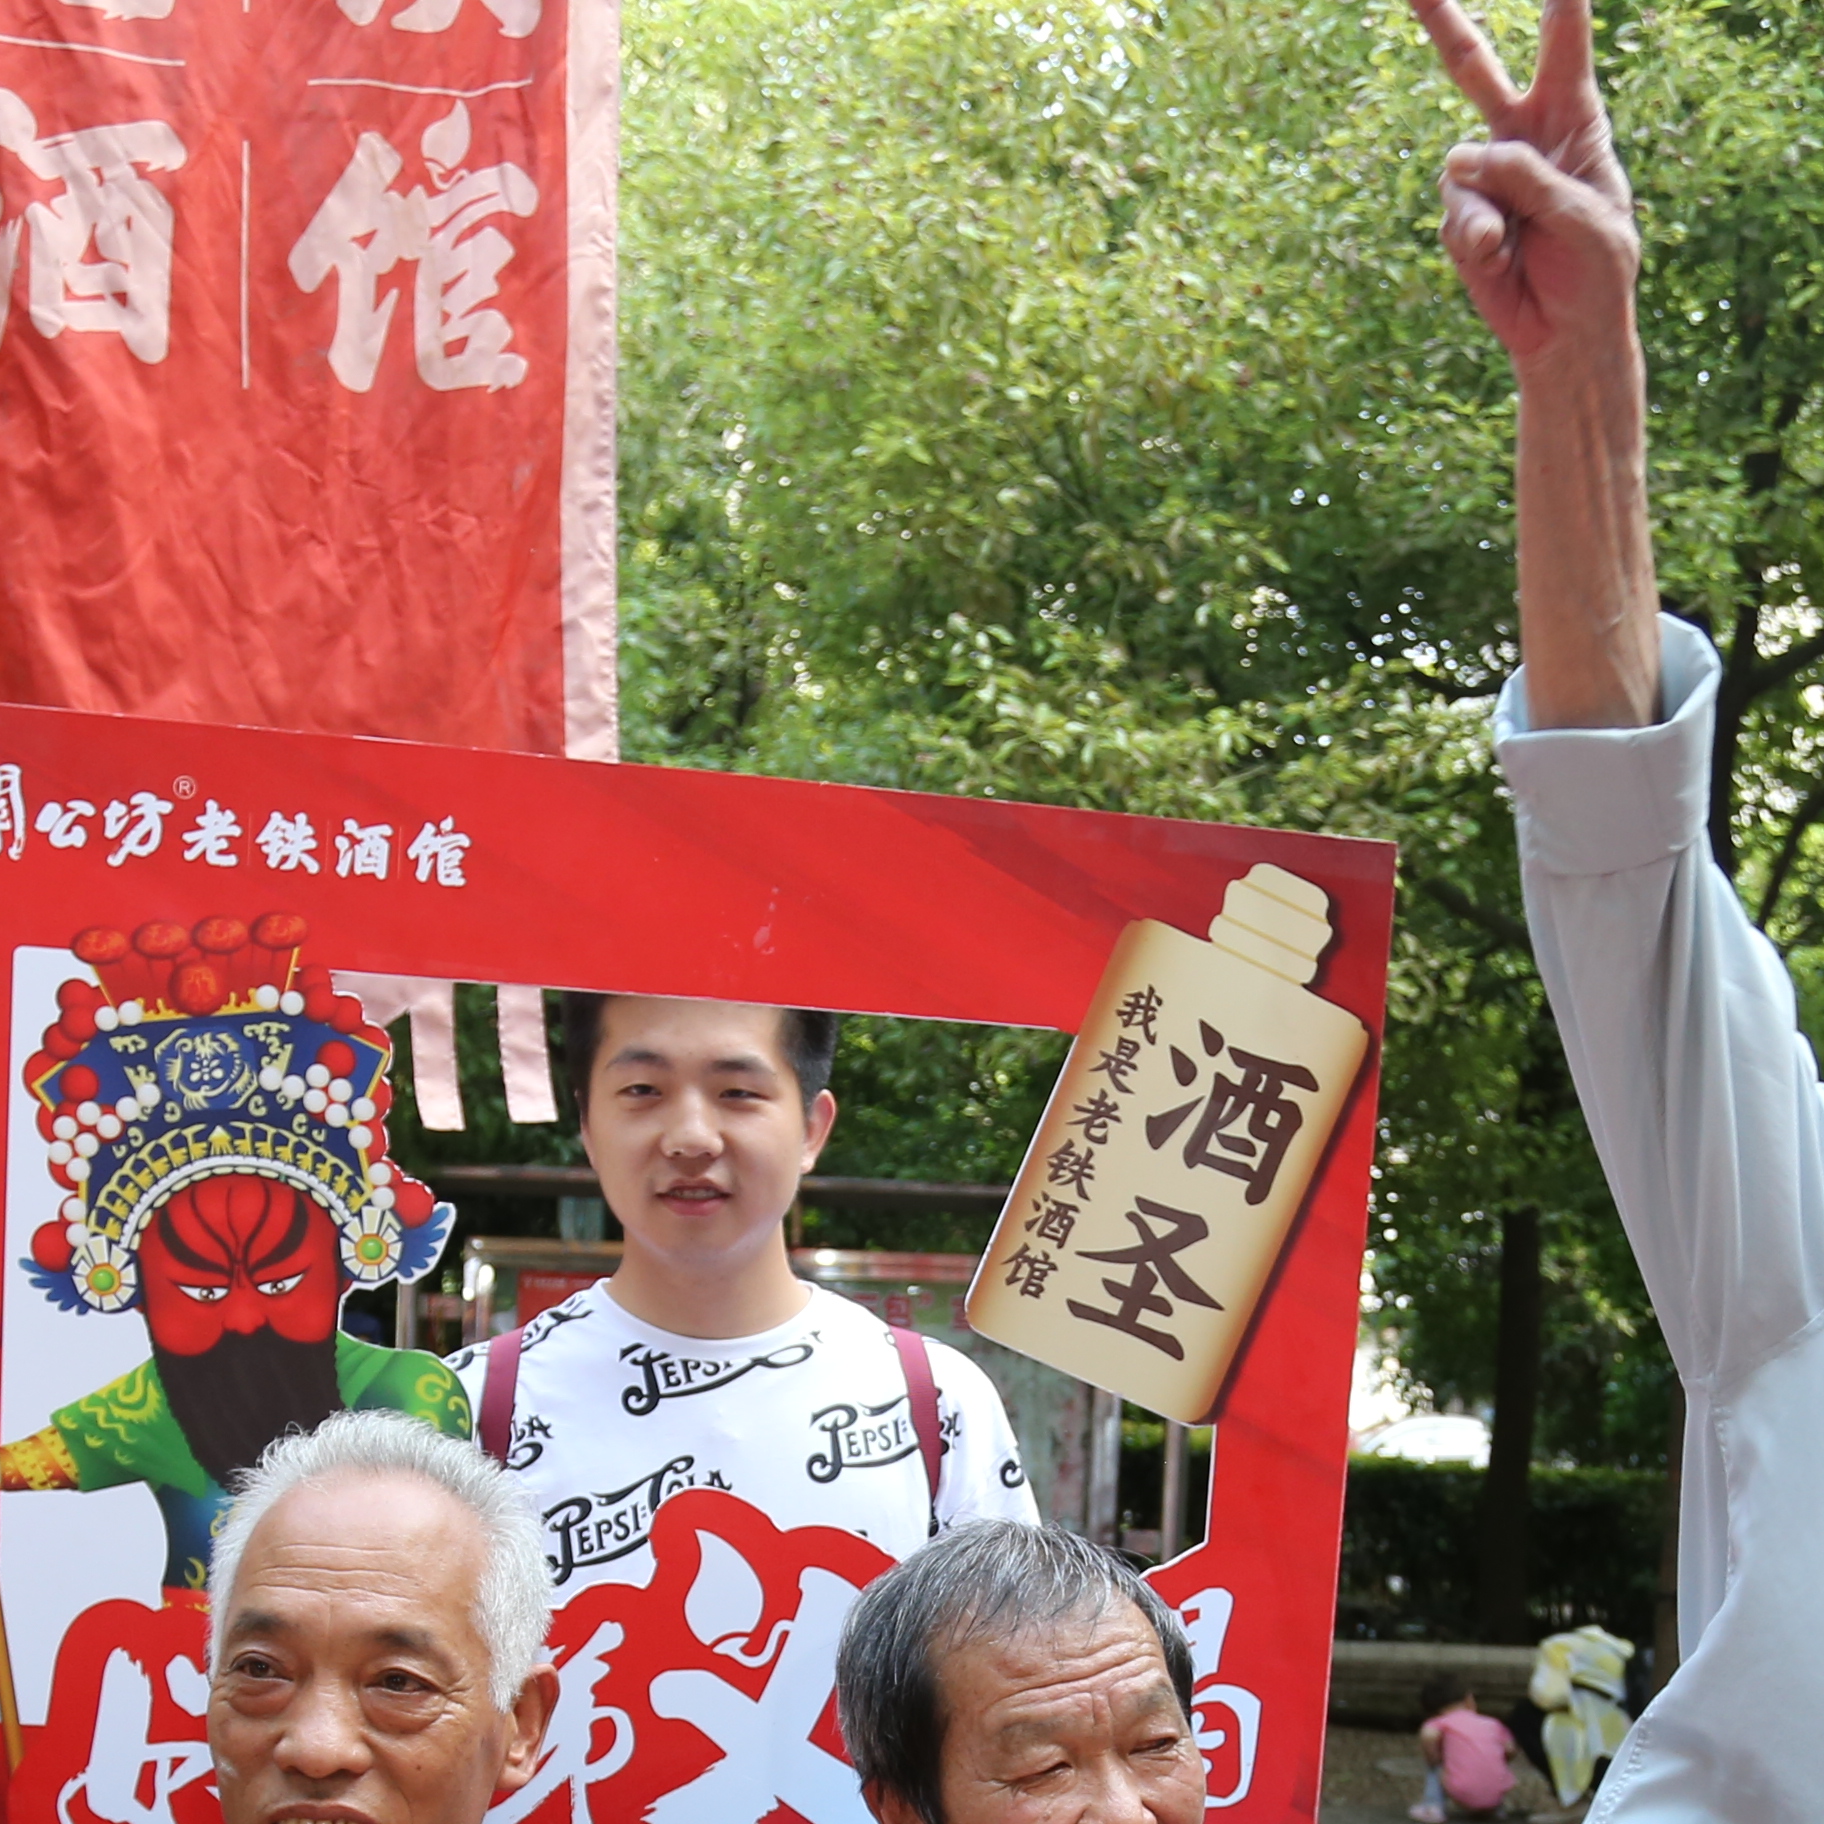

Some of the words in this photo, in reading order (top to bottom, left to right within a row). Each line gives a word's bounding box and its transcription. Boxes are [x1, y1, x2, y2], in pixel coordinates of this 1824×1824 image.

[1001, 985, 1164, 1300] 我是老铁酒馆
[1065, 1018, 1320, 1361] 酒圣
